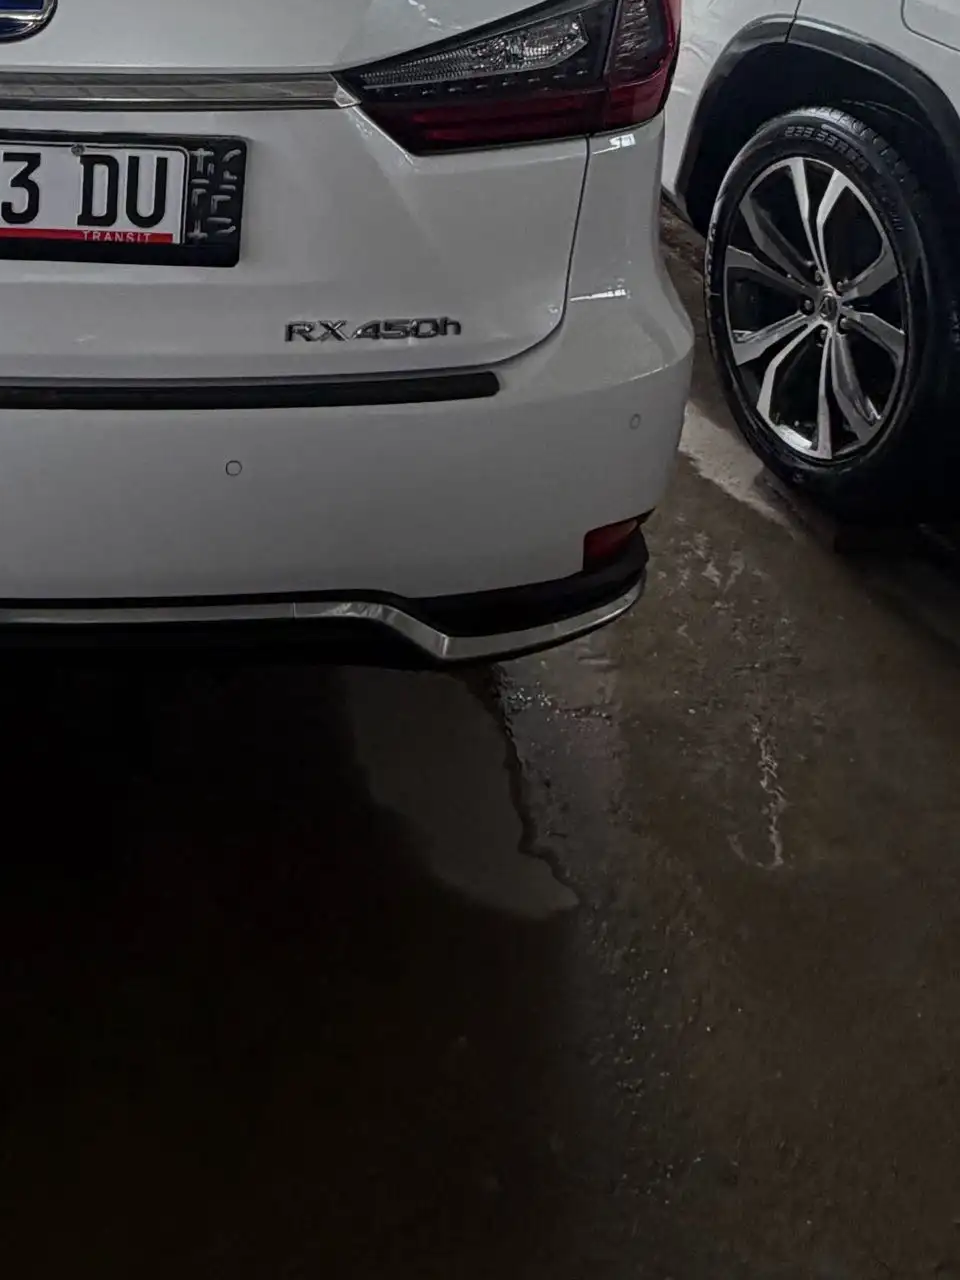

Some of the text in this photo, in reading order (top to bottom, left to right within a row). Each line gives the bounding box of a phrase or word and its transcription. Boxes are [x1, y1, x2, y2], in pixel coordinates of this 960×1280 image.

[77, 154, 168, 228] DU
[82, 230, 152, 243] TRANSIT
[284, 317, 461, 342] RX 450h
